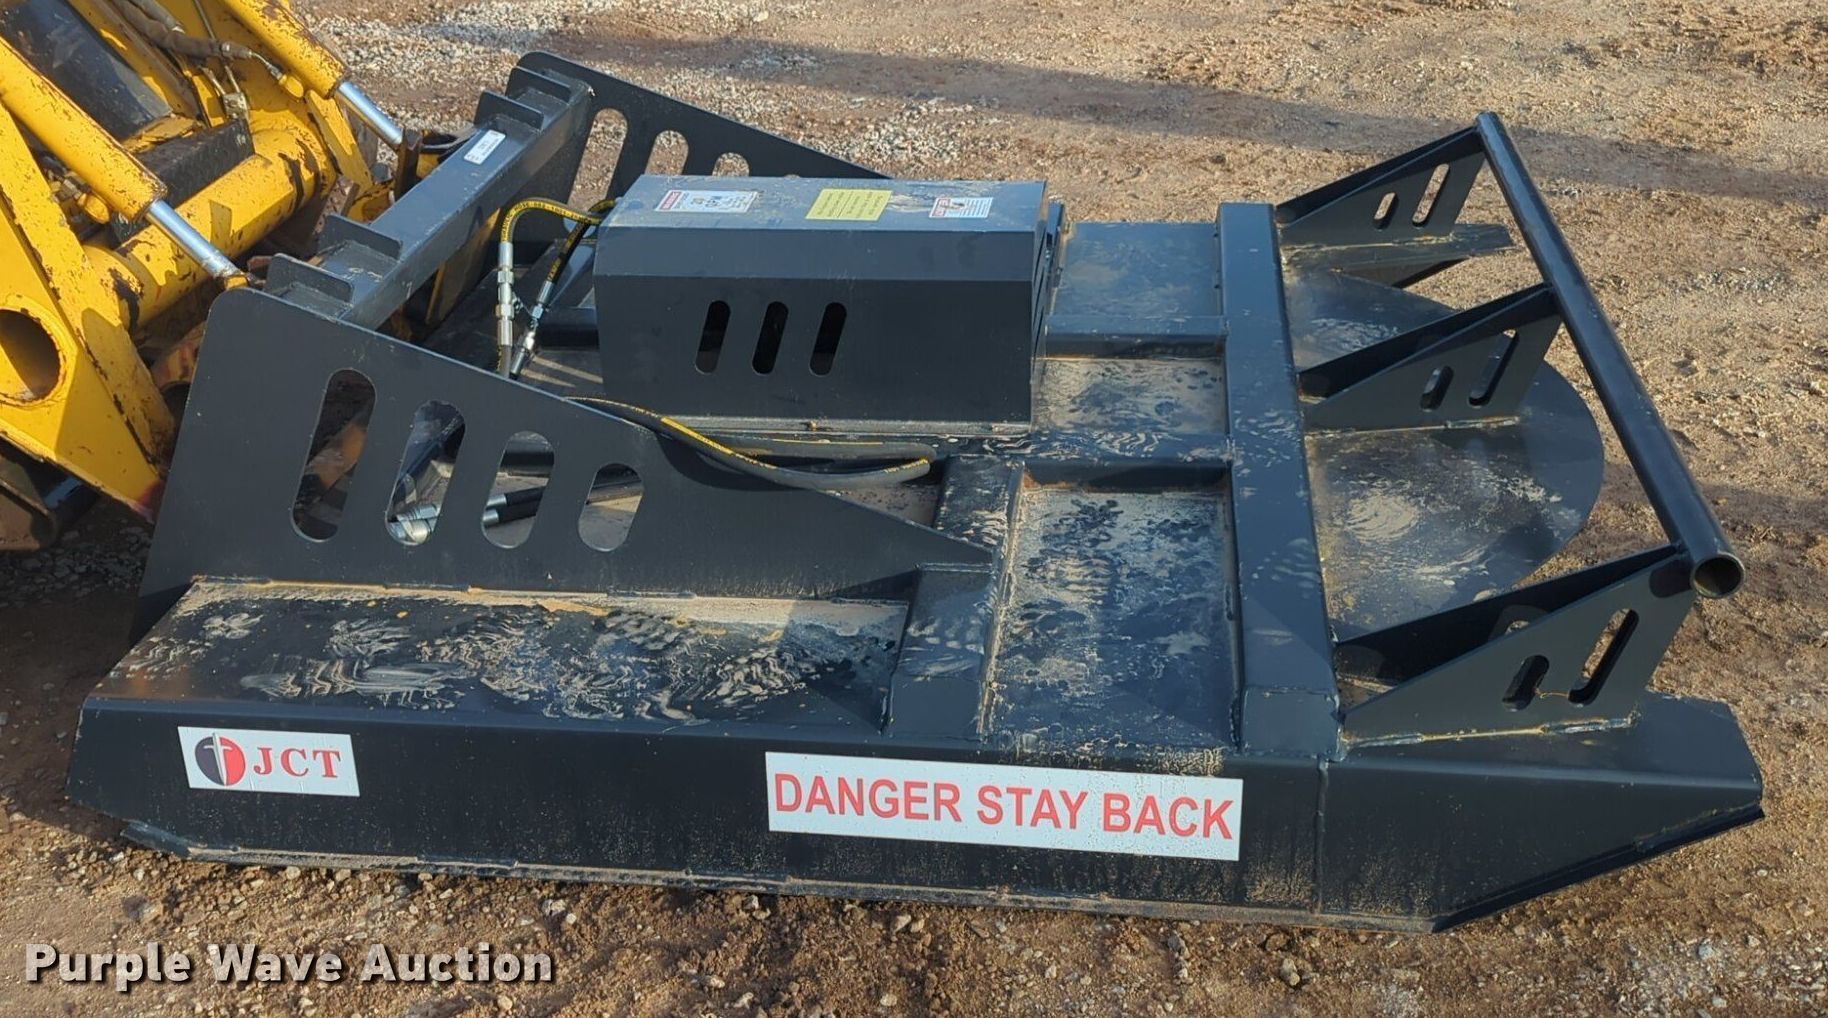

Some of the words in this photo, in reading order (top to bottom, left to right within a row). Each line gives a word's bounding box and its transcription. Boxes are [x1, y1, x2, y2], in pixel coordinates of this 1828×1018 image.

[253, 747, 341, 778] JCT
[774, 773, 962, 822] DANGER
[977, 785, 1088, 830] STAY
[1103, 793, 1234, 840] BACK
